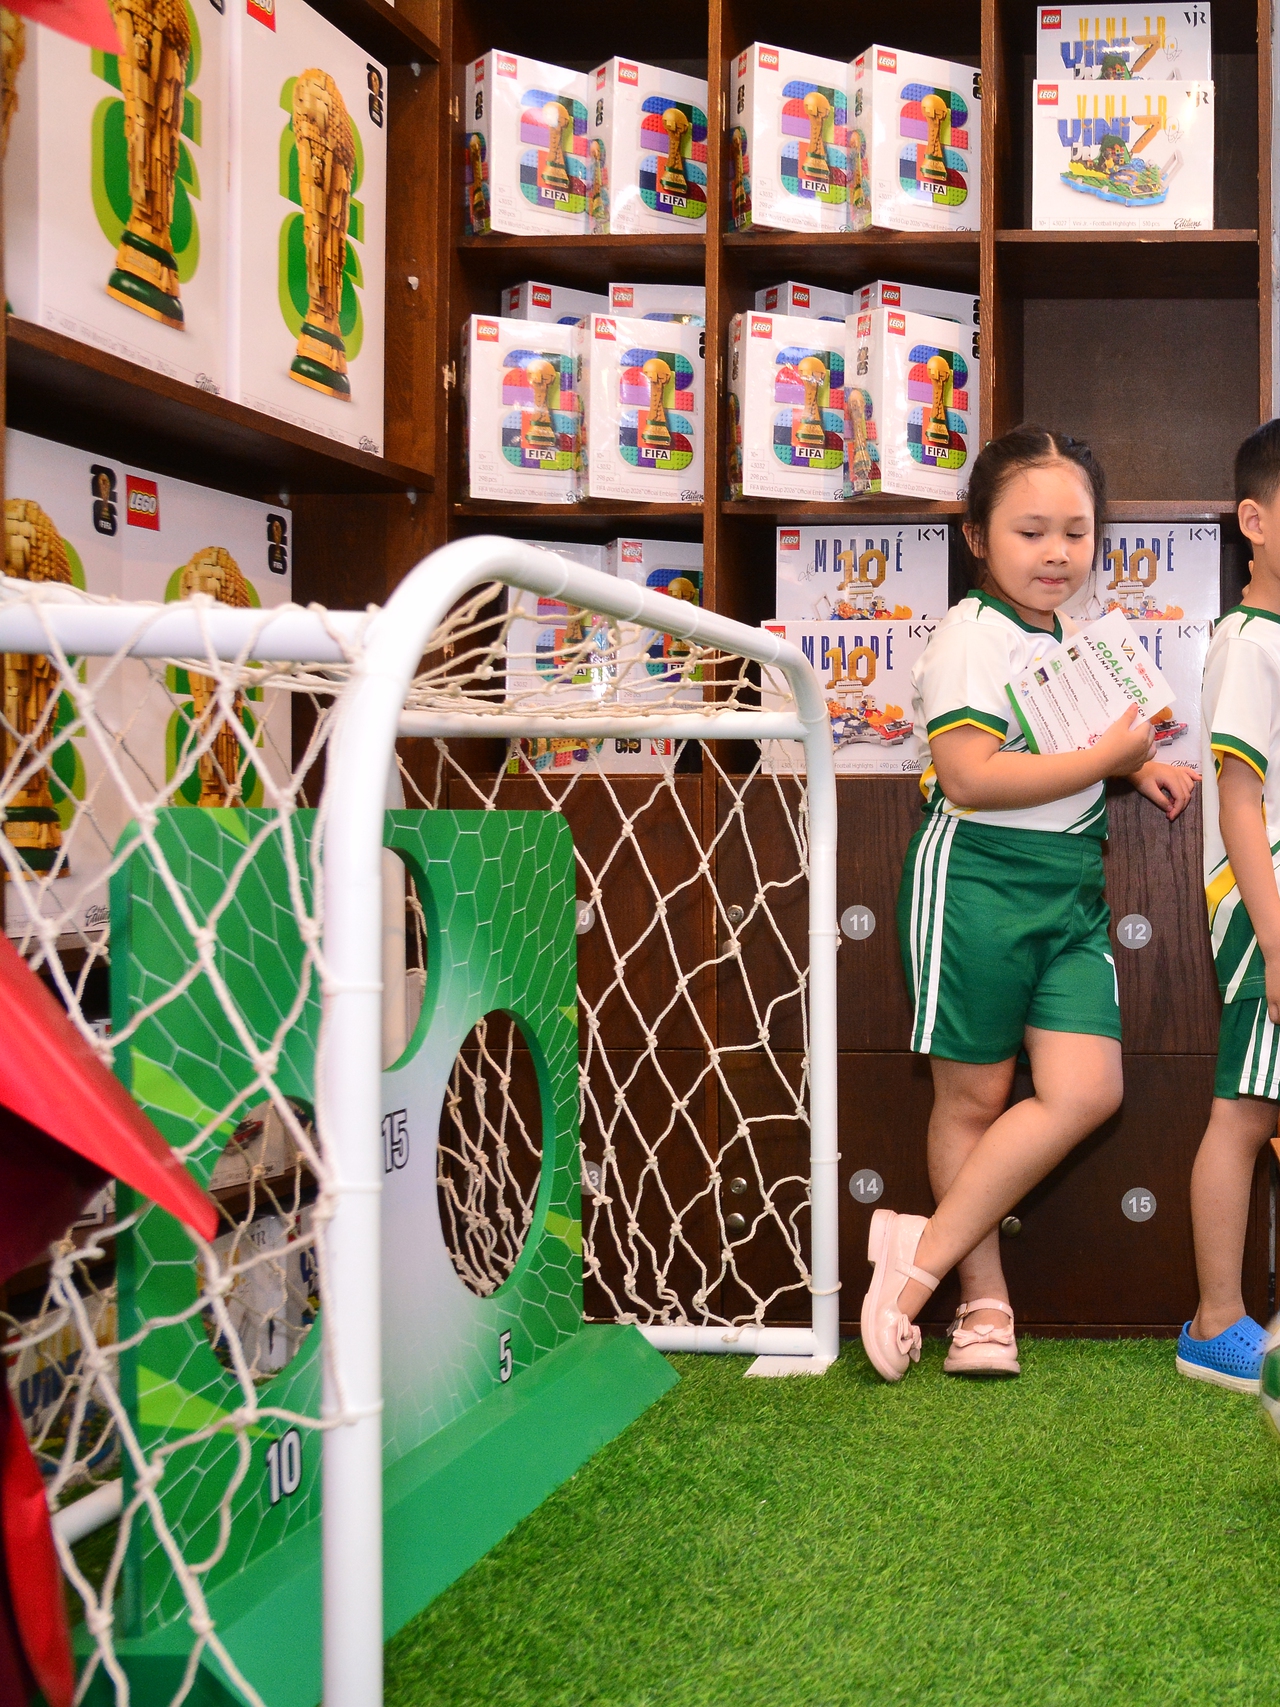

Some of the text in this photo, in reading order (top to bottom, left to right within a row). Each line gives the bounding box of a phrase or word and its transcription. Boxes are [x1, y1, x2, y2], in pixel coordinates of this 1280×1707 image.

[1042, 14, 1061, 24] LEGO
[1038, 90, 1058, 99] LEGO
[805, 180, 827, 192] FIFA
[923, 182, 945, 194] FIFA
[544, 189, 567, 201] FIFA
[663, 194, 686, 206] FIFA
[533, 292, 550, 302] LEGO
[793, 291, 809, 302] LEGO
[883, 290, 899, 300] LEGO
[478, 325, 498, 335] LEGO
[753, 323, 771, 333] LEGO
[889, 319, 905, 329] LEGO
[529, 450, 553, 460] FIFA
[645, 449, 668, 459] FIFA
[799, 448, 822, 458] FIFA
[928, 447, 947, 458] FIFA
[129, 492, 157, 515] LEGO
[781, 535, 799, 545] LEGO
[836, 548, 887, 591] 10
[1106, 548, 1158, 591] 10
[825, 646, 877, 690] 10
[1097, 641, 1123, 675] GOAL
[1122, 676, 1149, 705] KIDS
[849, 915, 869, 930] 11
[1124, 924, 1146, 940] 12
[381, 1108, 409, 1174] 15
[855, 1178, 878, 1194] 14
[1128, 1197, 1151, 1213] 15
[500, 1327, 512, 1384] 5
[265, 1429, 301, 1507] 10
